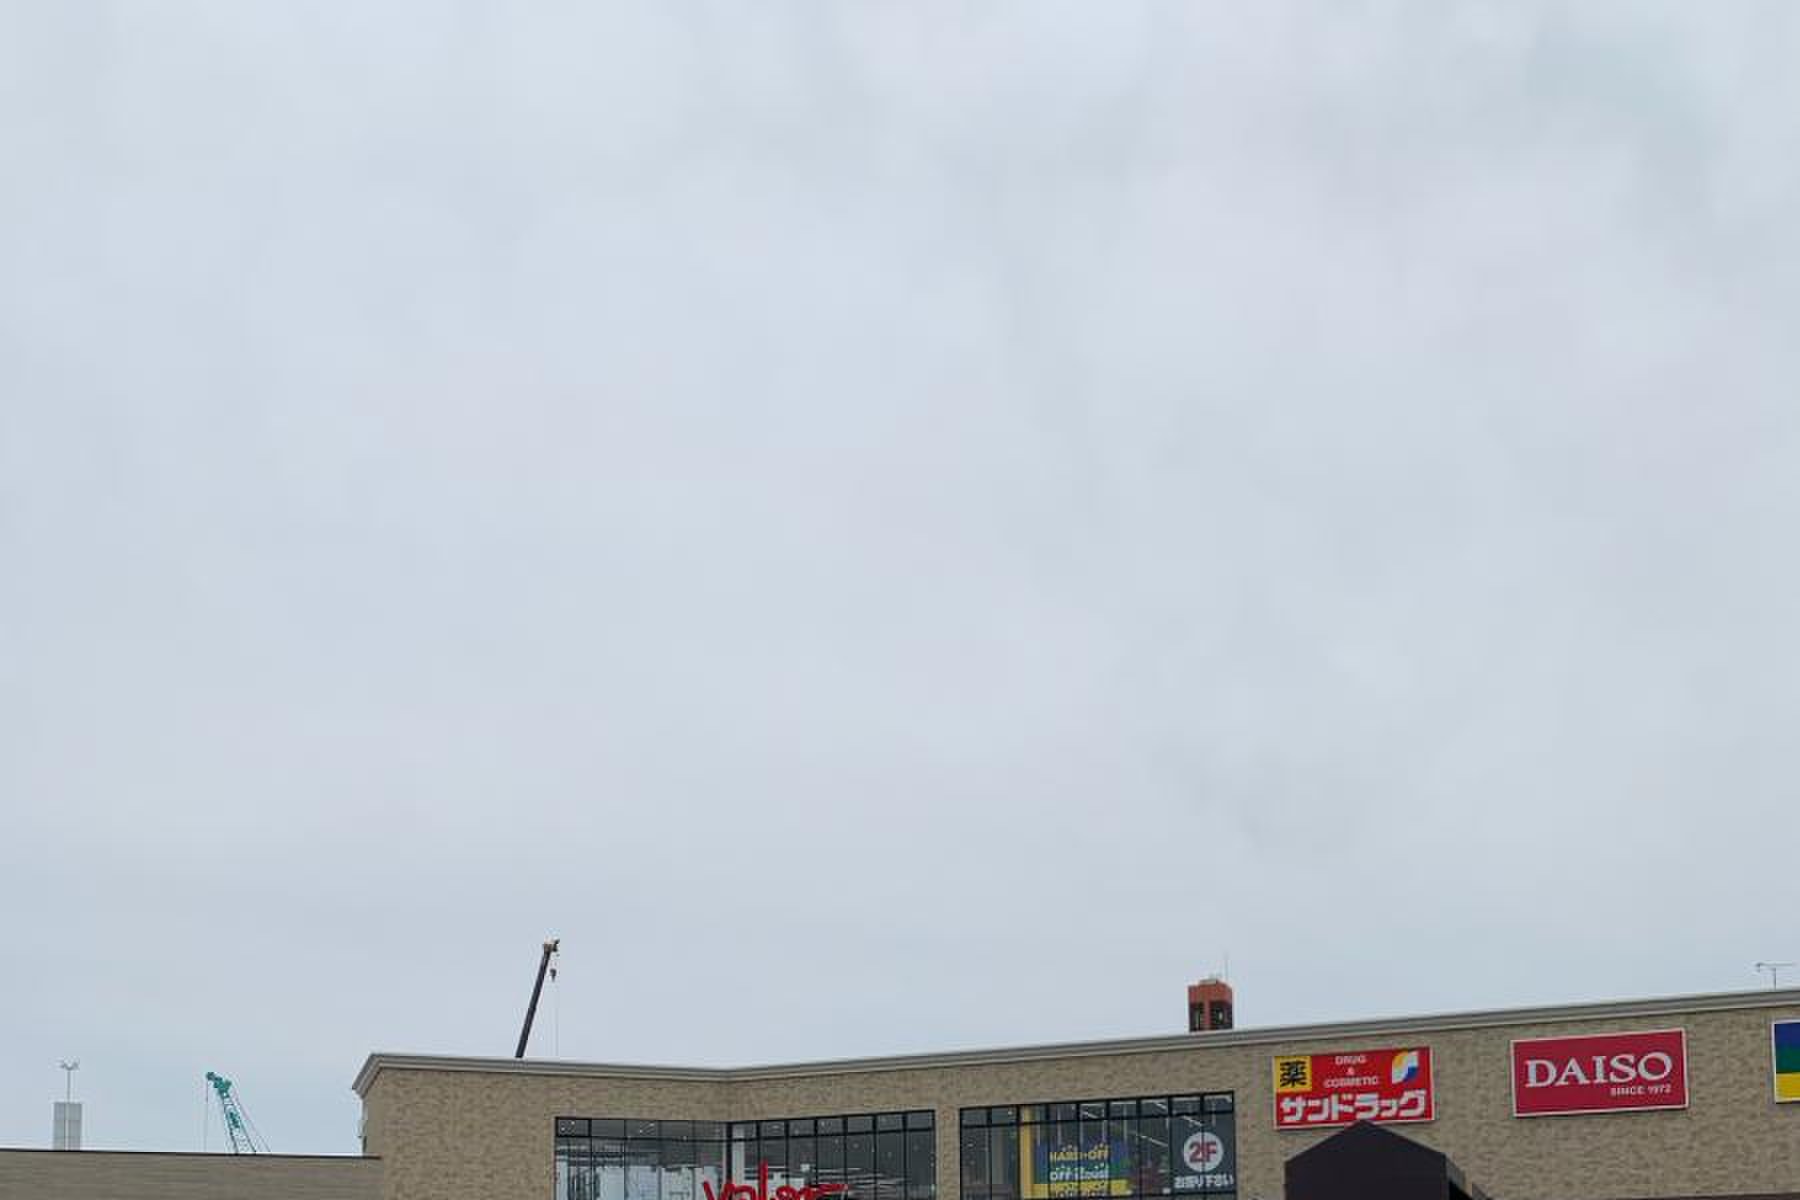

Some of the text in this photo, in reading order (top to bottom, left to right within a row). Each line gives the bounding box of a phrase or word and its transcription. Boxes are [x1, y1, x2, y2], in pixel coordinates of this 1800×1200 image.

[1334, 1054, 1366, 1066] DRUG
[1525, 1052, 1673, 1088] DAISO
[1279, 1060, 1307, 1088] 薬
[1323, 1076, 1379, 1088] COSMETIC
[1610, 1083, 1671, 1097] SINCE 1972
[1280, 1089, 1427, 1122] サンドラッグ
[1188, 1141, 1217, 1163] 2F
